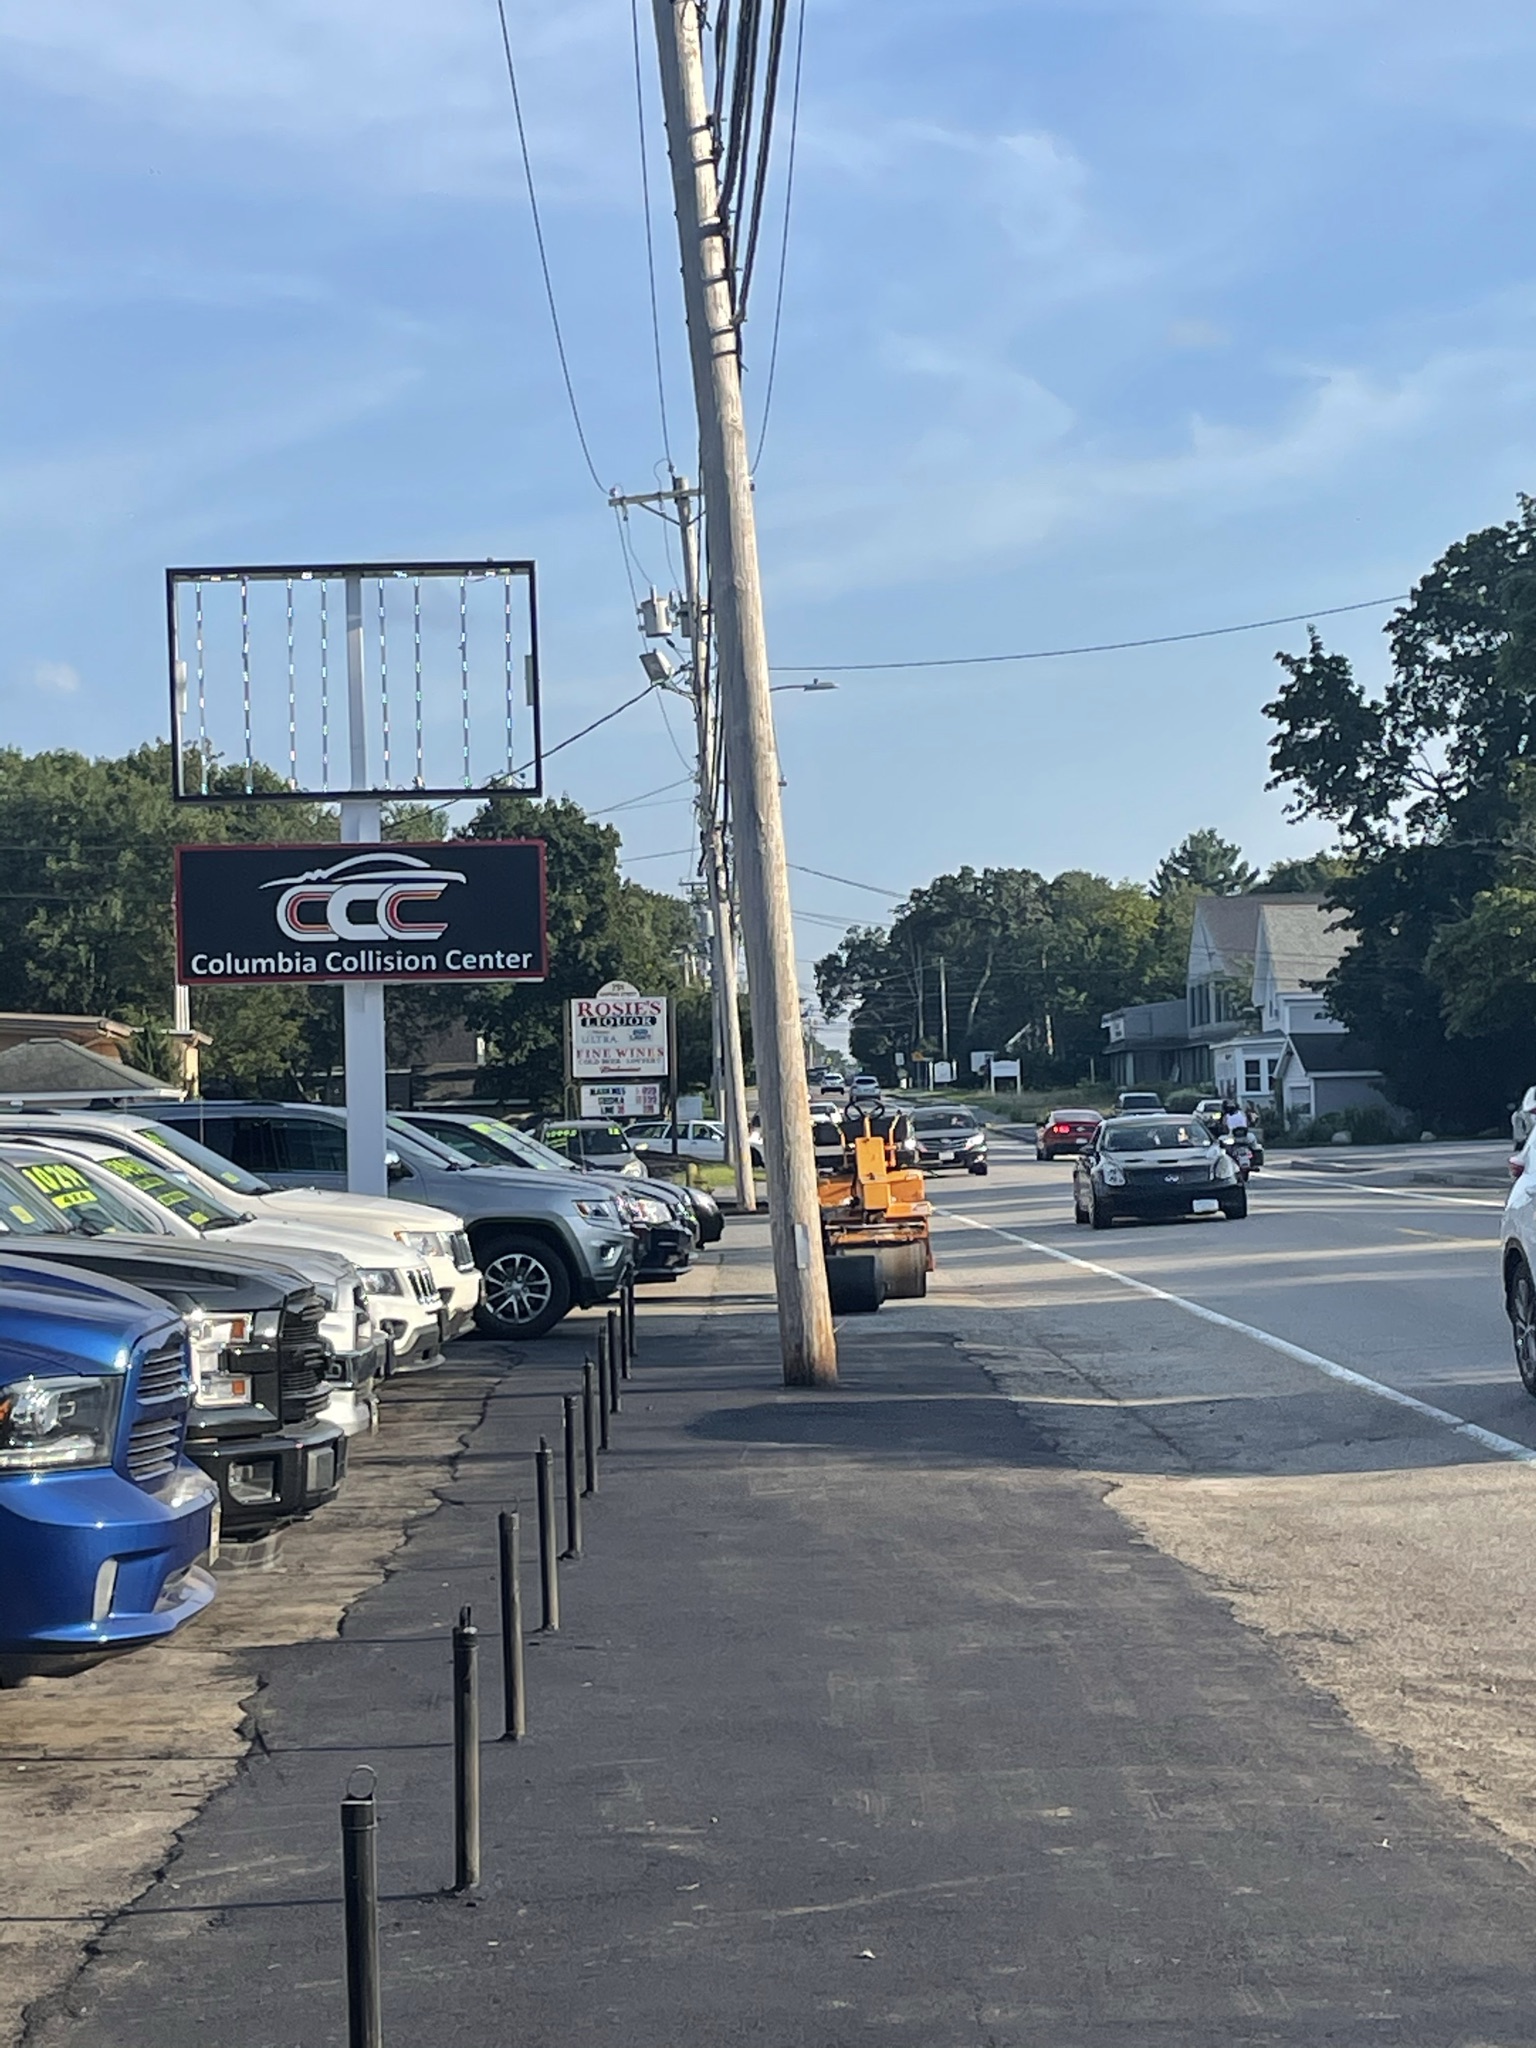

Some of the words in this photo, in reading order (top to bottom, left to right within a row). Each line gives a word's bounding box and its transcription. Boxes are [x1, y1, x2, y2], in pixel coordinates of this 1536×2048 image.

[191, 952, 317, 975] Columbia
[325, 950, 437, 973] Collision
[445, 948, 533, 972] Center
[578, 1001, 661, 1017] ROSIE'S
[584, 1016, 653, 1028] LIQUOR
[582, 1035, 617, 1044] ULTRA
[576, 1048, 611, 1059] FINE
[616, 1047, 664, 1058] WINES
